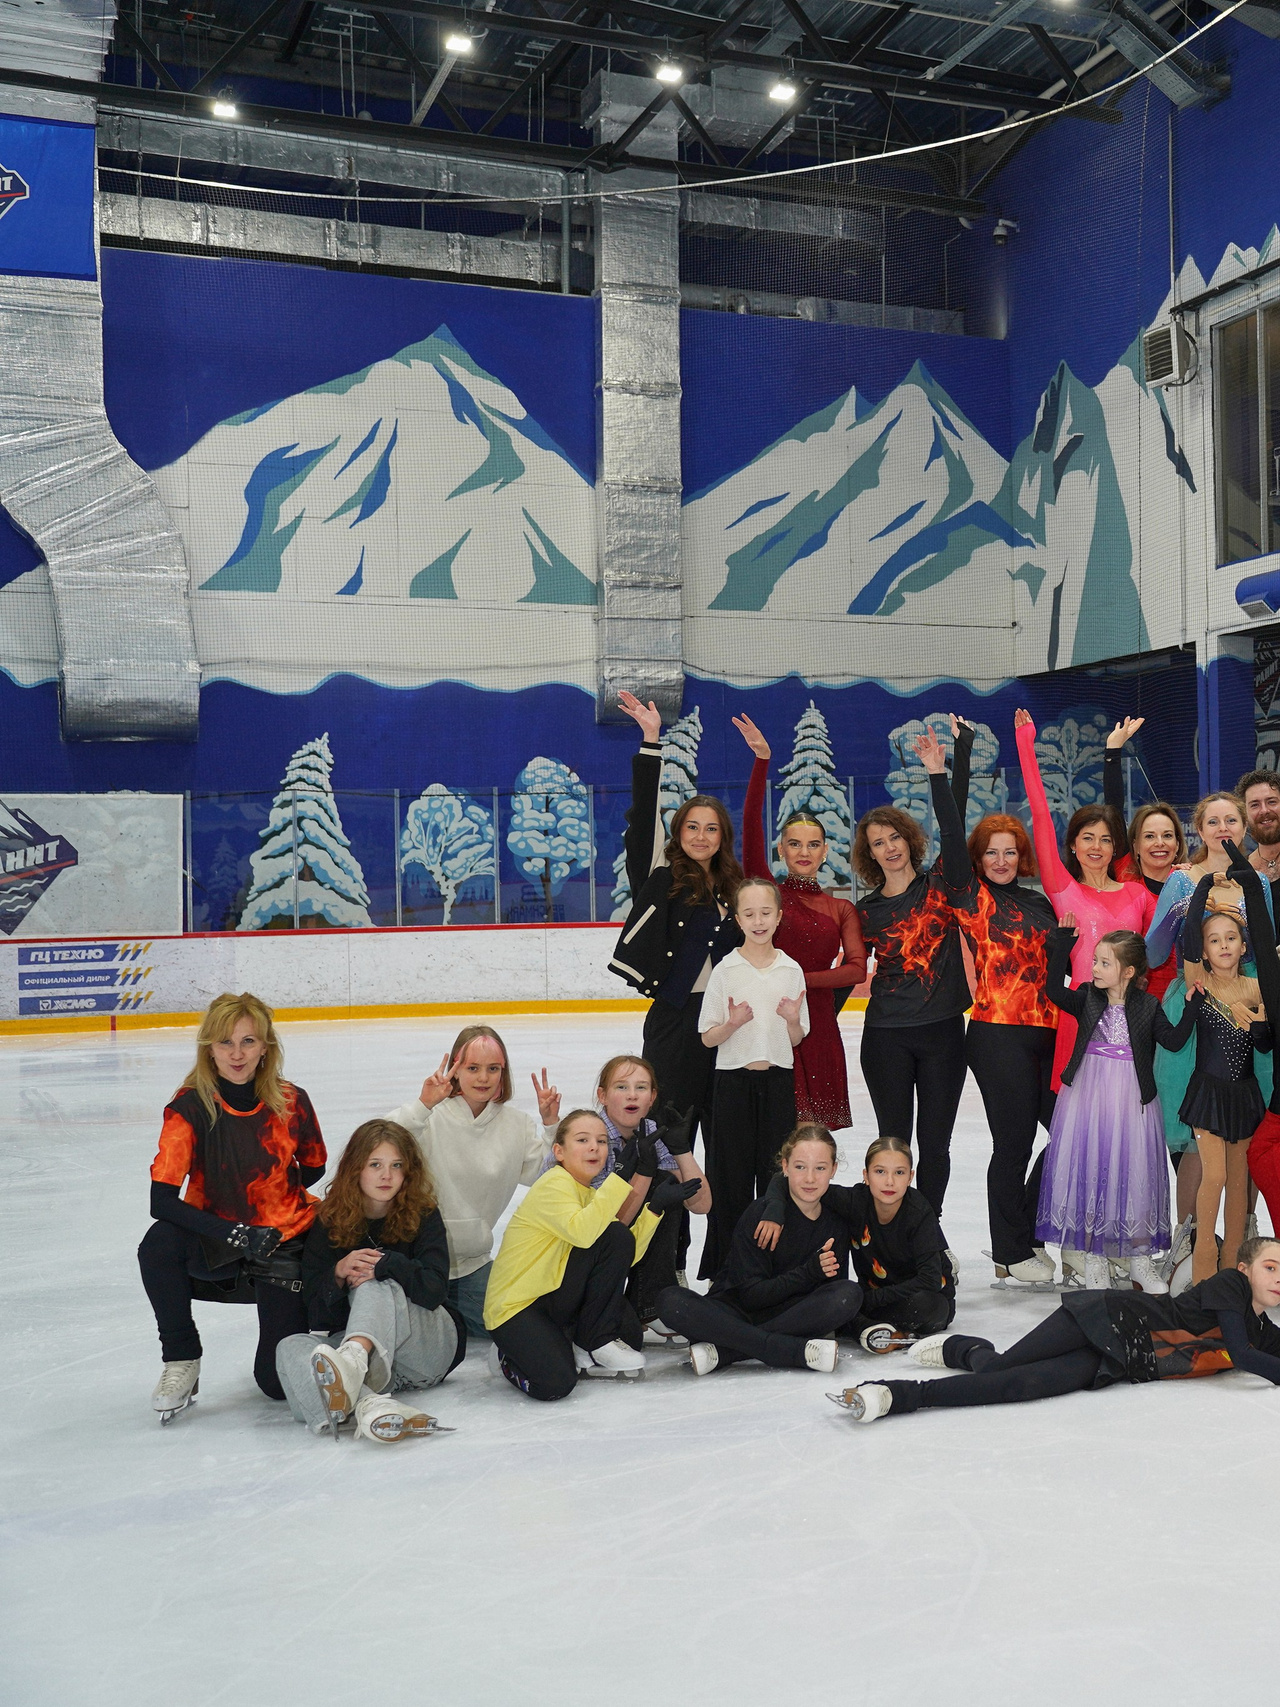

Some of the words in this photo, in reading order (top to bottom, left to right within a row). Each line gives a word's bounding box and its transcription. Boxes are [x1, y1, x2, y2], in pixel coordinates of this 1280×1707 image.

[1254, 659, 1279, 688] РАНИТ
[53, 948, 105, 961] ТЕХНО
[24, 975, 85, 985] ОФИЦИАЛЬНЫЙ
[86, 975, 111, 984] ДИЛЕР
